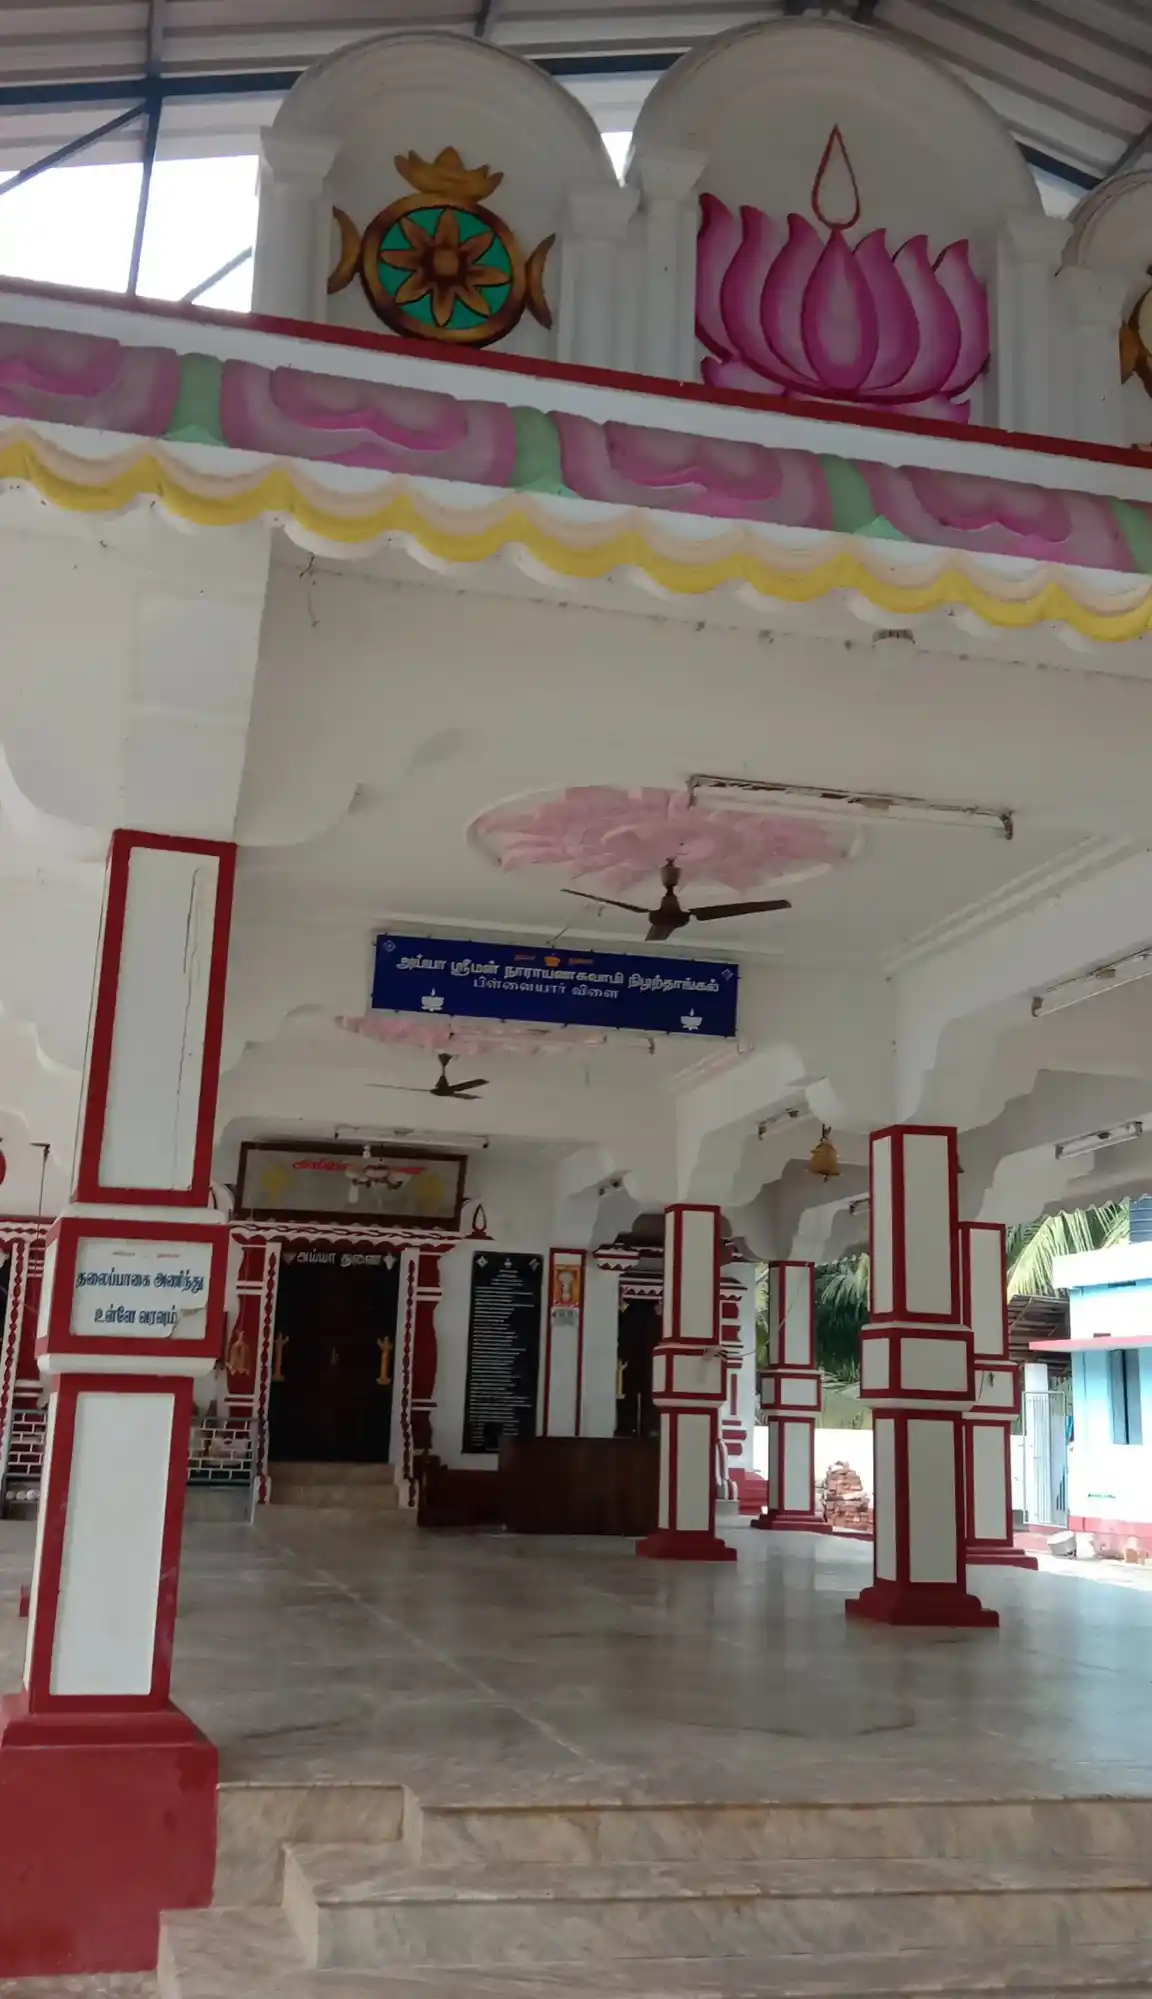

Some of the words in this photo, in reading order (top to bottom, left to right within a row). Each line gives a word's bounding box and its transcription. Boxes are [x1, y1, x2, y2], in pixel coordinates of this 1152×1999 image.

[396, 954, 447, 971] அய்யா
[473, 975, 566, 995] பிள்ளையார்
[571, 984, 619, 999] விளை
[297, 1249, 336, 1264] அய்யா
[76, 1267, 151, 1289] தலைப்பாகை
[154, 1269, 204, 1293] அணிந்து
[94, 1304, 136, 1323] உள்ளே
[139, 1305, 178, 1326] வரவும்
